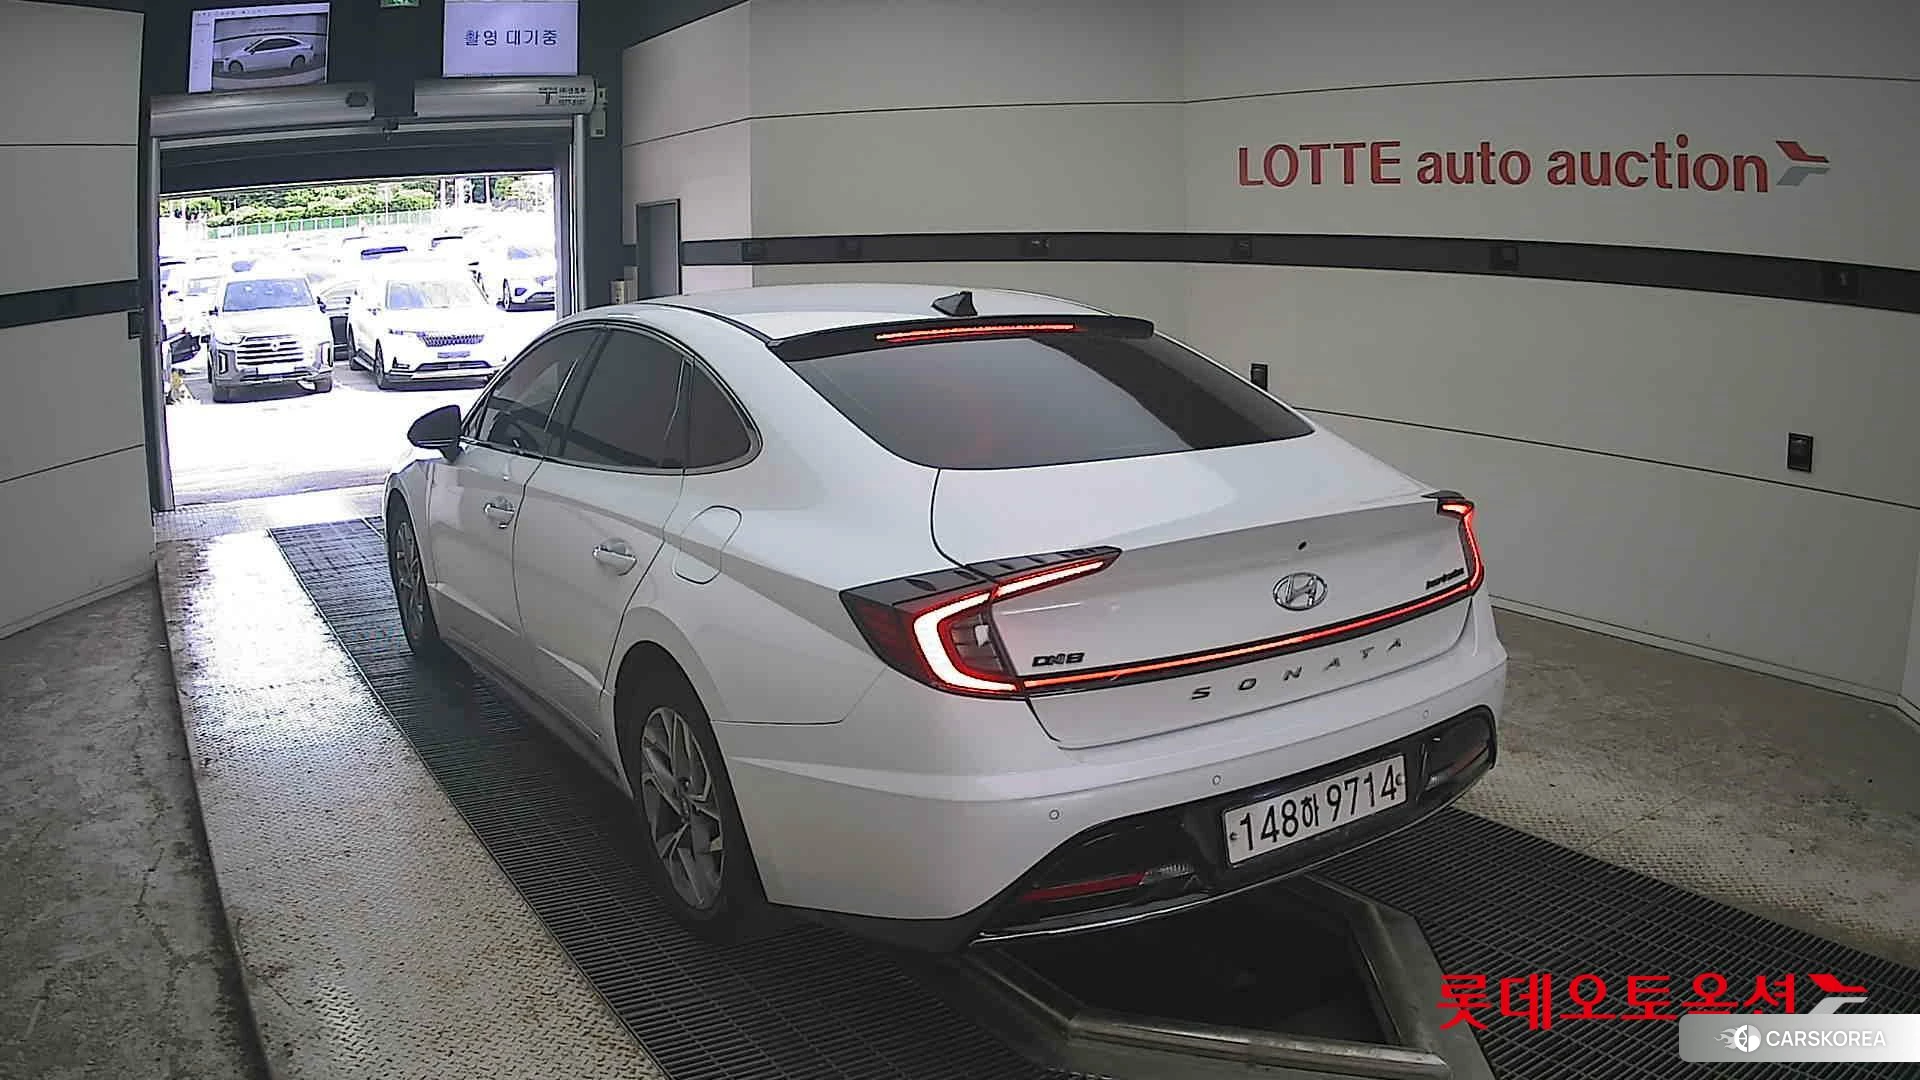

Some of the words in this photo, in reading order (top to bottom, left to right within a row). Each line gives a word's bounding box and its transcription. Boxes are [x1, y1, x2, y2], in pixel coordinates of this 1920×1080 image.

[506, 29, 558, 46] 대기중
[1239, 141, 1401, 187] LOTTE
[1416, 141, 1532, 185] auto
[1547, 133, 1768, 193] auction
[1191, 638, 1403, 700] SONATA
